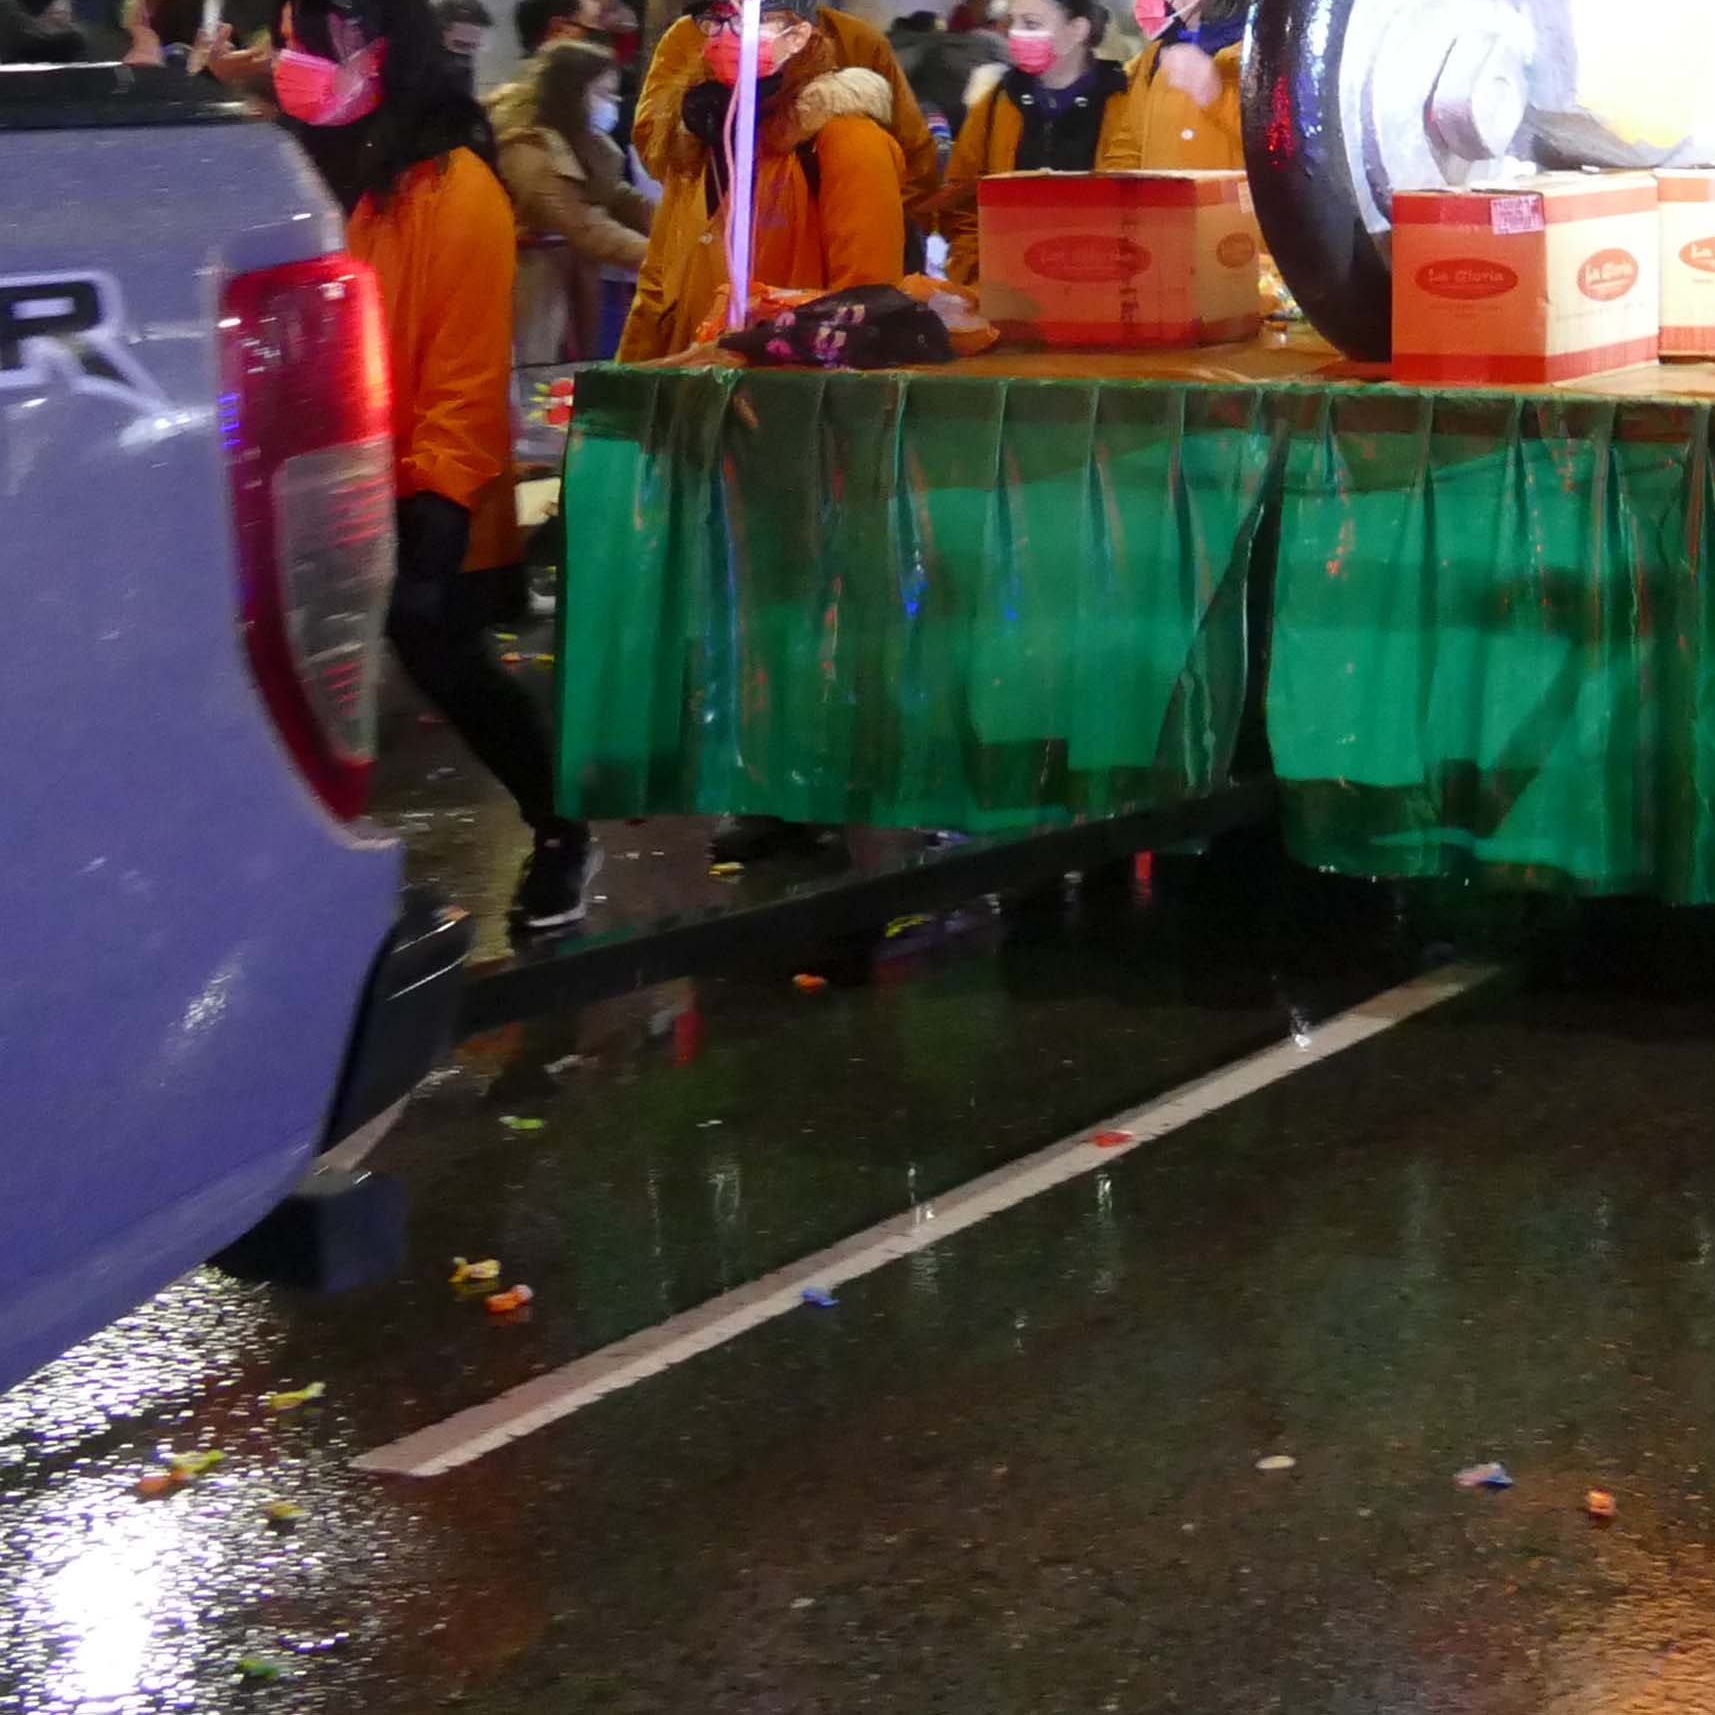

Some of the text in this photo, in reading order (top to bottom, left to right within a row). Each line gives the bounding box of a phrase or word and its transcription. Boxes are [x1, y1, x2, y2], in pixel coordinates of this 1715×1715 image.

[1690, 243, 1712, 260] La
[1427, 268, 1504, 283] La Gloria
[1583, 262, 1601, 284] La
